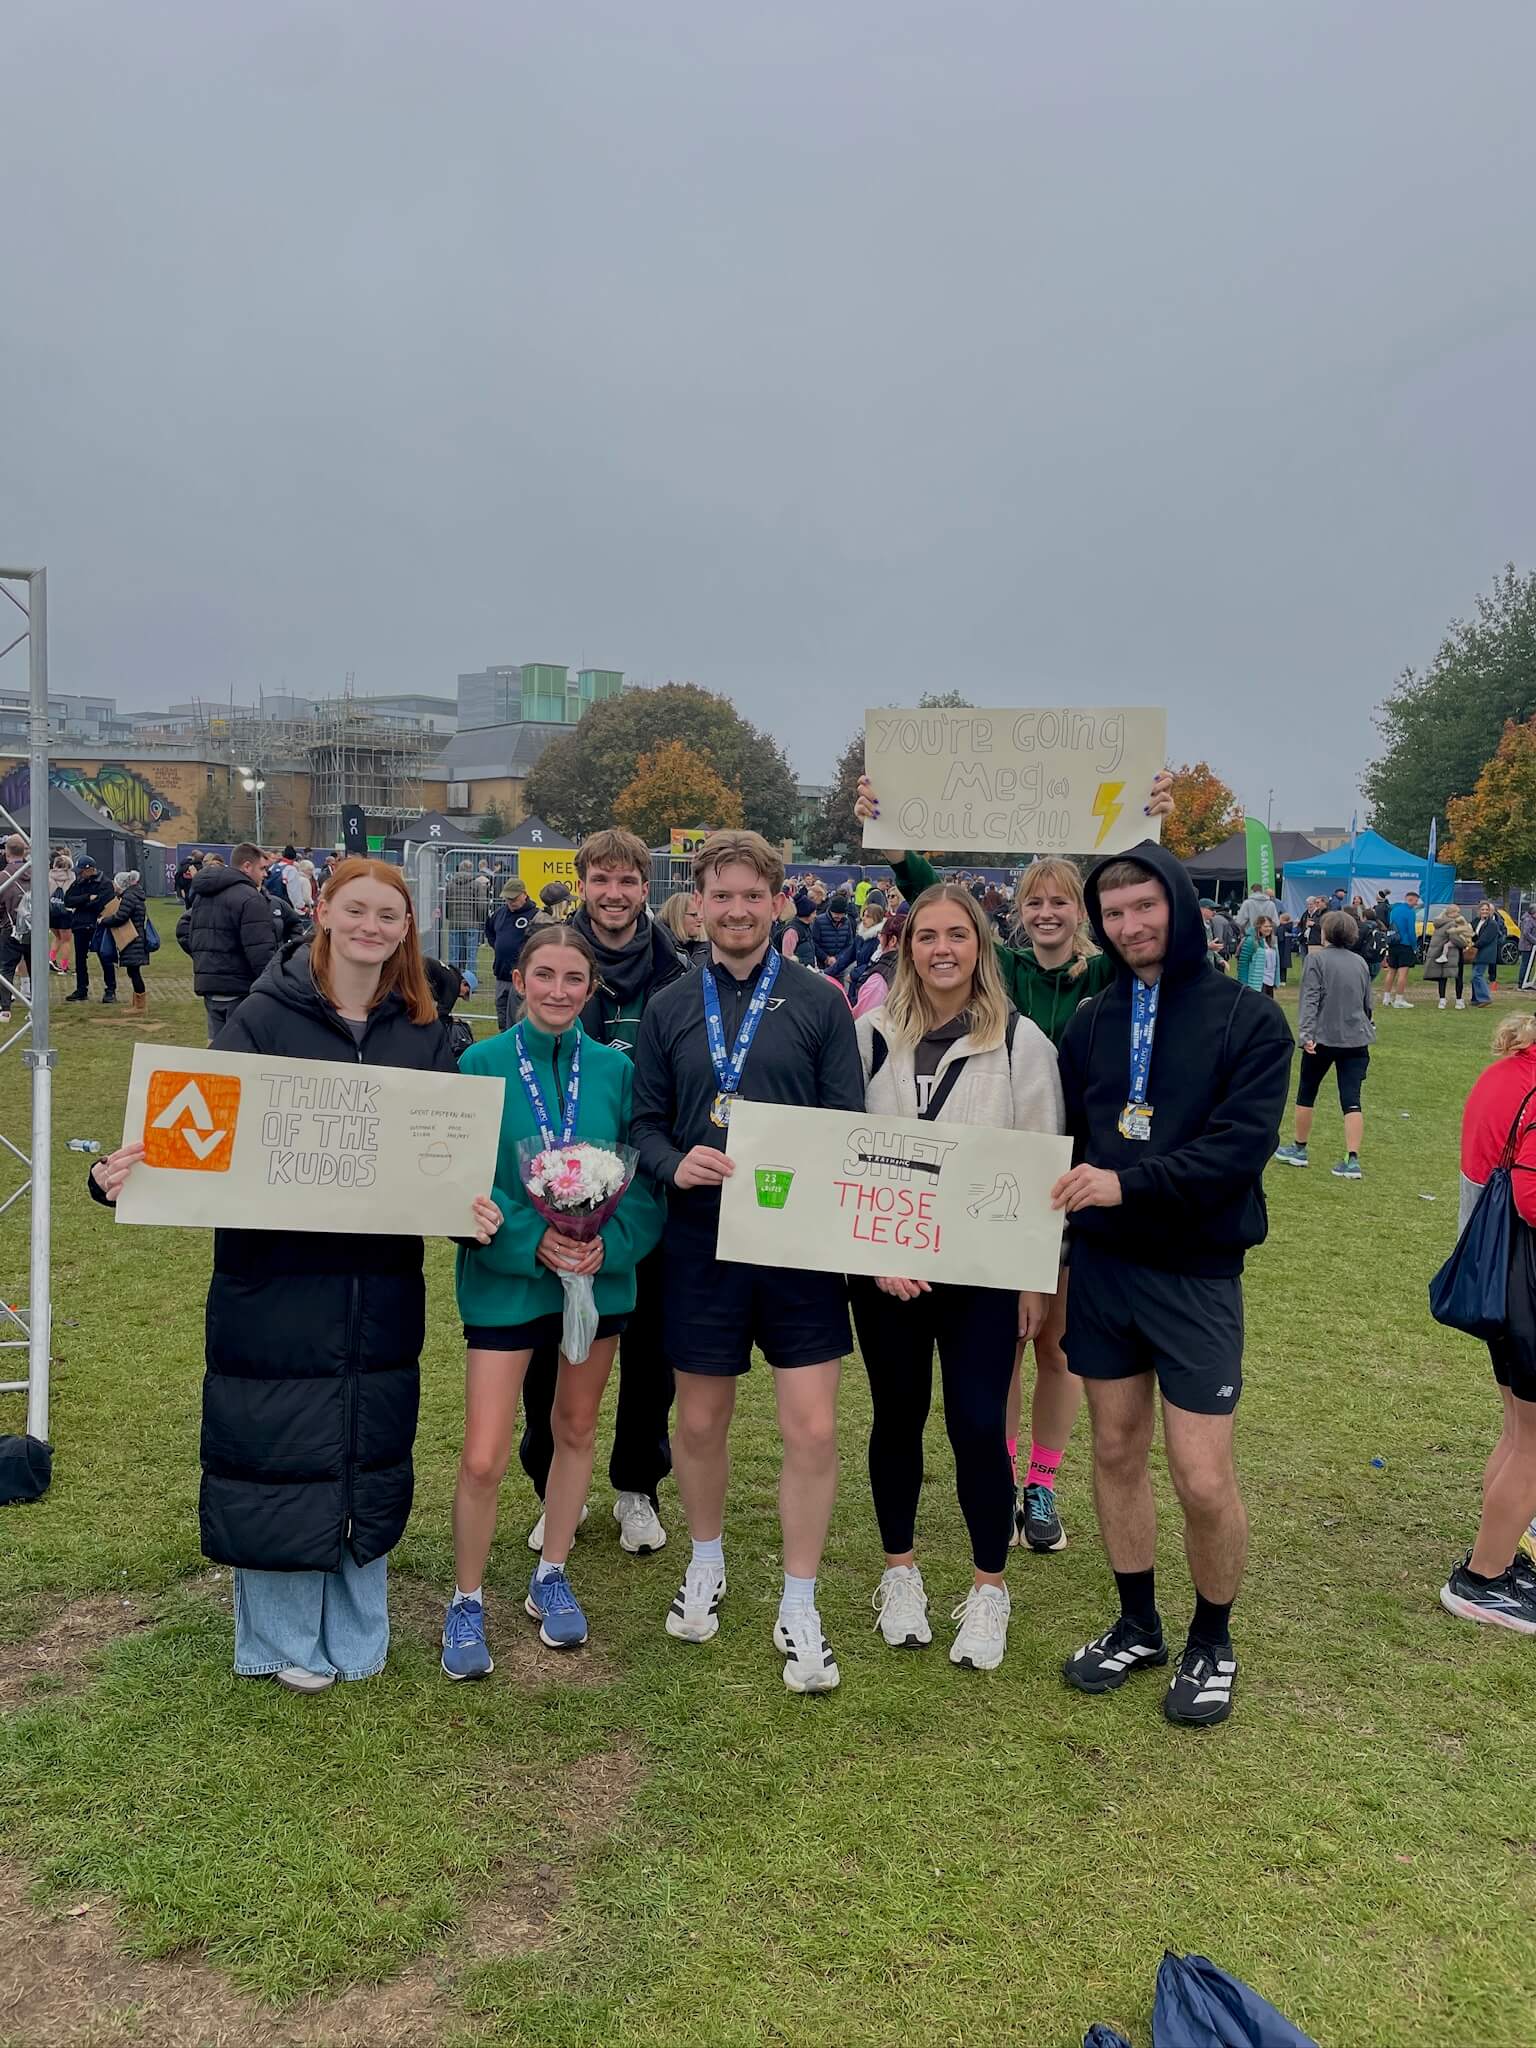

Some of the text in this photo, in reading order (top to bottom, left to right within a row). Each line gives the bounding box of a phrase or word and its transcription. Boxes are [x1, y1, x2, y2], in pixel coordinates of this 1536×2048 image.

[543, 861, 575, 873] MEE
[261, 1073, 381, 1113] THINK
[262, 1112, 381, 1151] OF THE
[268, 1150, 377, 1187] KUDOS
[866, 1155, 910, 1167] TRAINING
[833, 1181, 937, 1220] THOSE
[853, 1214, 941, 1253] LEGS!
[1031, 1461, 1056, 1475] PSR
